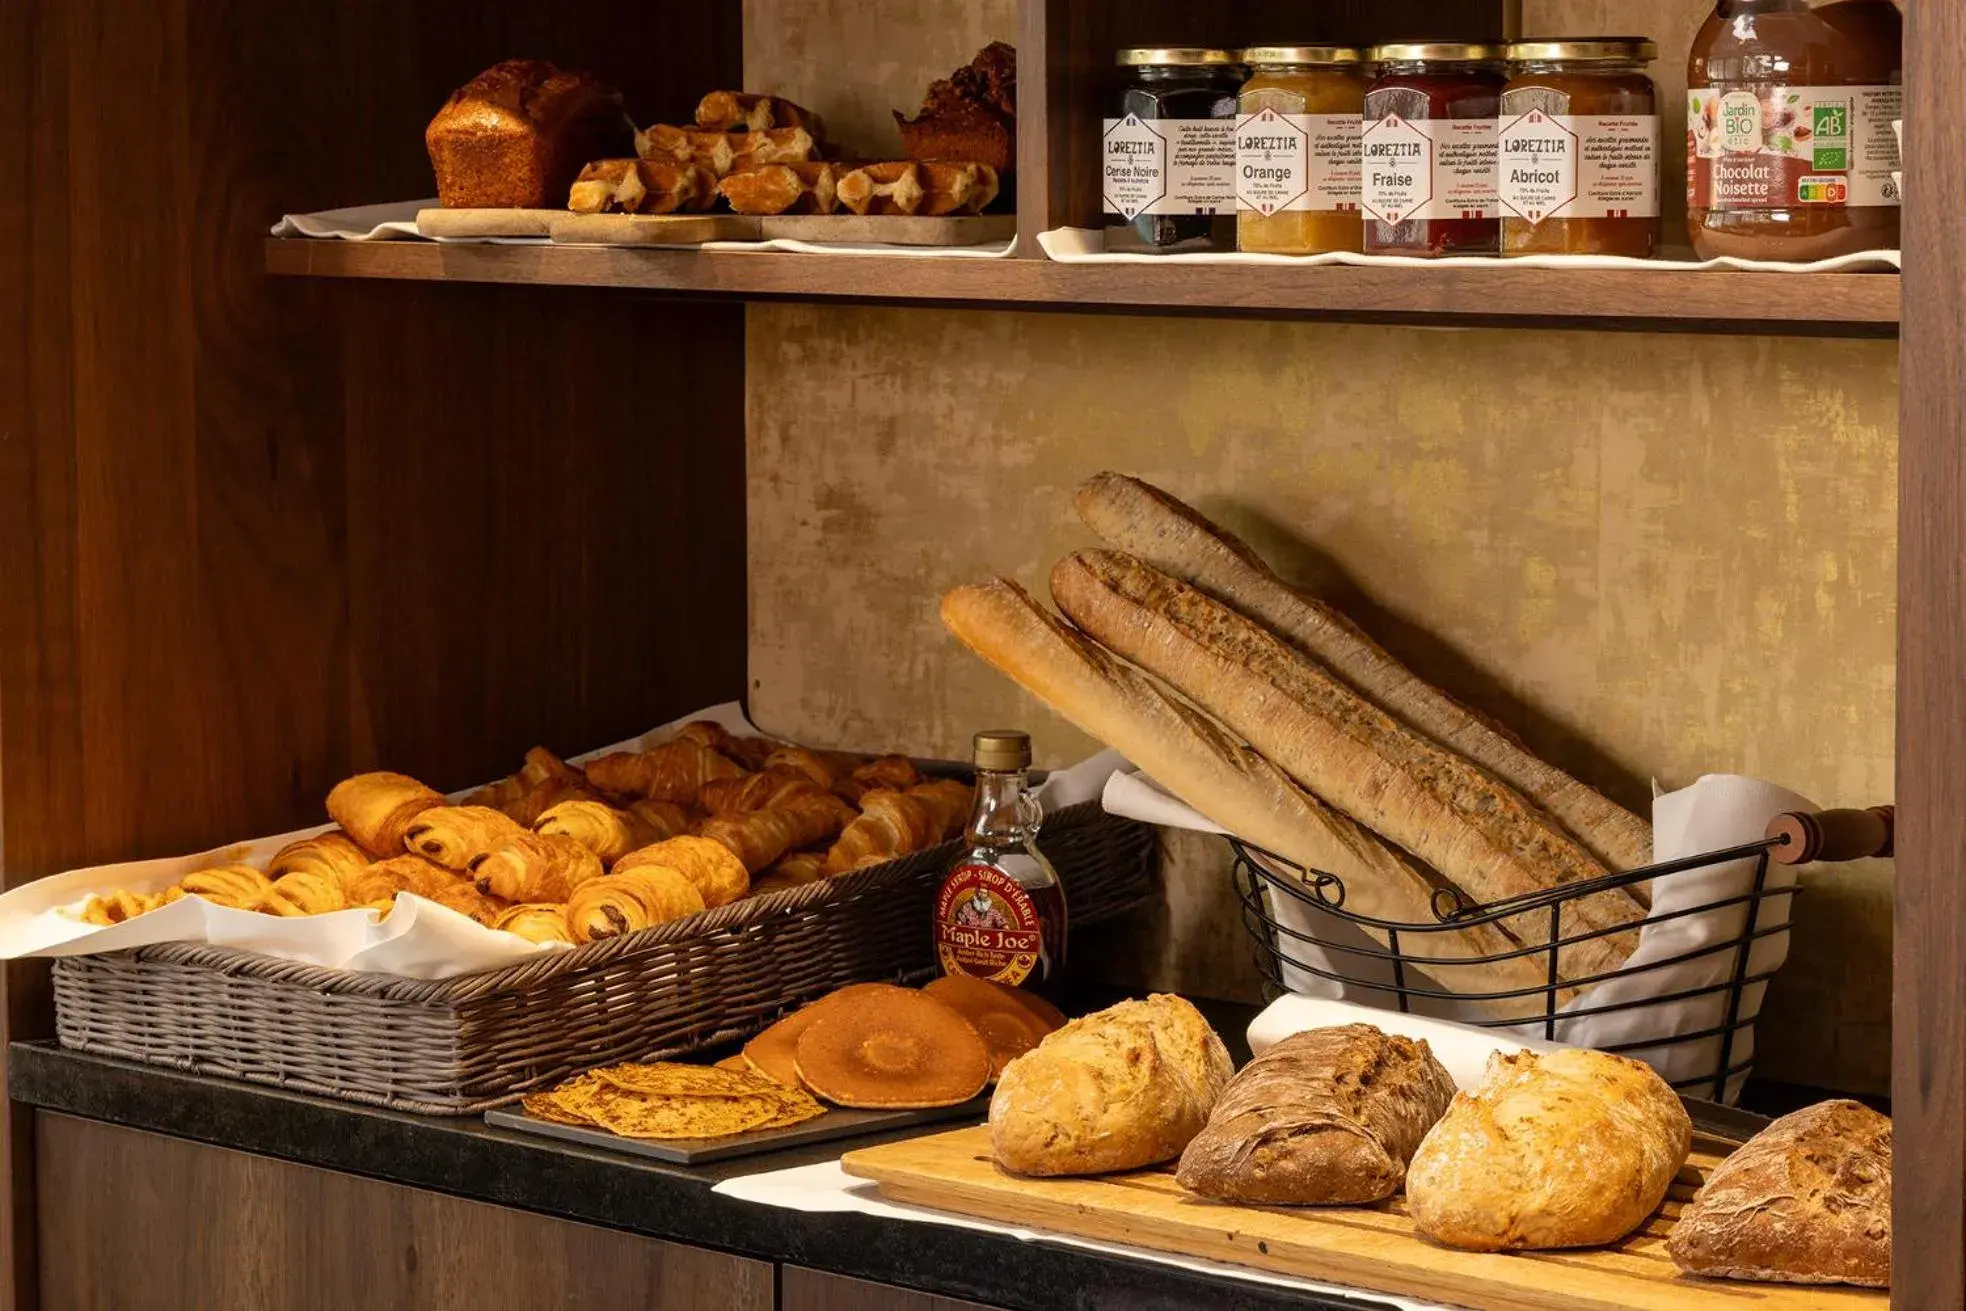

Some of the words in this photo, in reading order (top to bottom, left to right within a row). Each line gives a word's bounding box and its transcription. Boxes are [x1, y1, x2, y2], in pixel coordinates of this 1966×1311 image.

[1722, 102, 1756, 117] Jardin
[1815, 117, 1842, 135] AB
[1108, 141, 1155, 154] LOREZTIA
[1238, 137, 1297, 150] LOREZTIA
[1363, 143, 1422, 157] LOREZTIA
[1504, 139, 1566, 153] LOREZTIA
[1105, 166, 1132, 177] Cerise
[1133, 166, 1159, 178] Noire
[1243, 165, 1292, 182] Orange
[1510, 169, 1560, 183] Abricot
[1712, 164, 1770, 179] Chocolat
[1372, 173, 1413, 186] Fraise
[1713, 180, 1769, 196] Noisette
[1828, 187, 1836, 197] D
[978, 871, 1005, 886] SIROP
[942, 924, 991, 947] Maple
